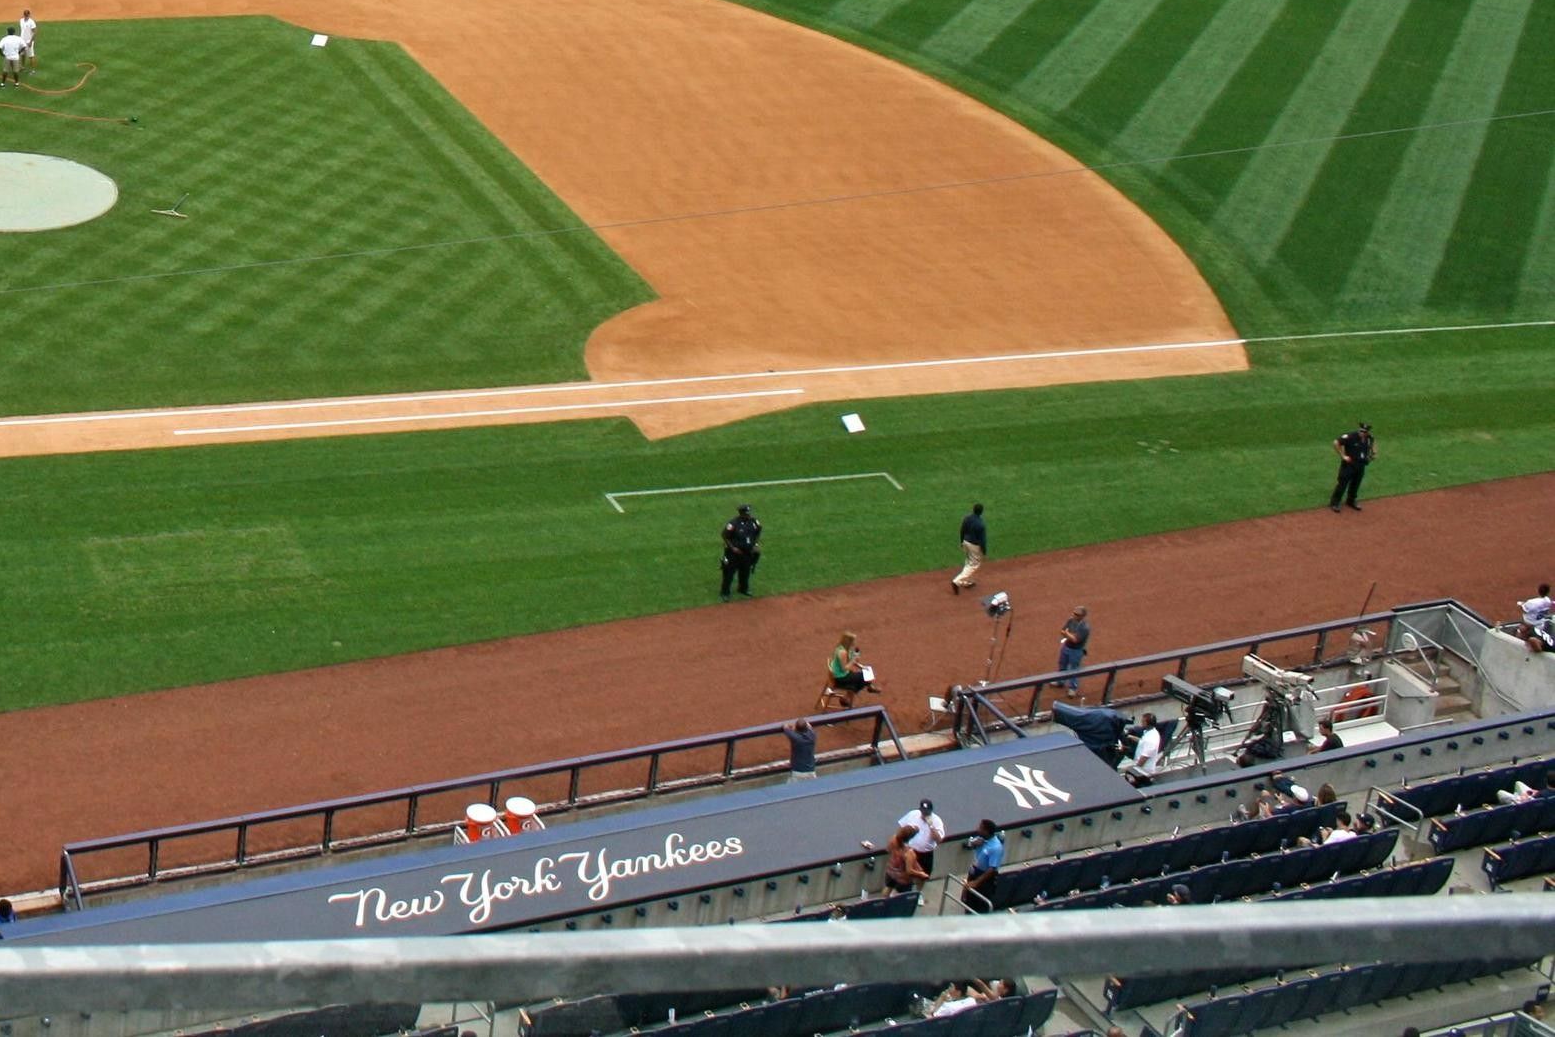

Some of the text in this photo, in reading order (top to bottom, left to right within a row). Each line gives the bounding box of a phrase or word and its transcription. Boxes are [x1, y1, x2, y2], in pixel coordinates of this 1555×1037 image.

[993, 763, 1071, 809] NY
[328, 833, 744, 927] New York Yankees
